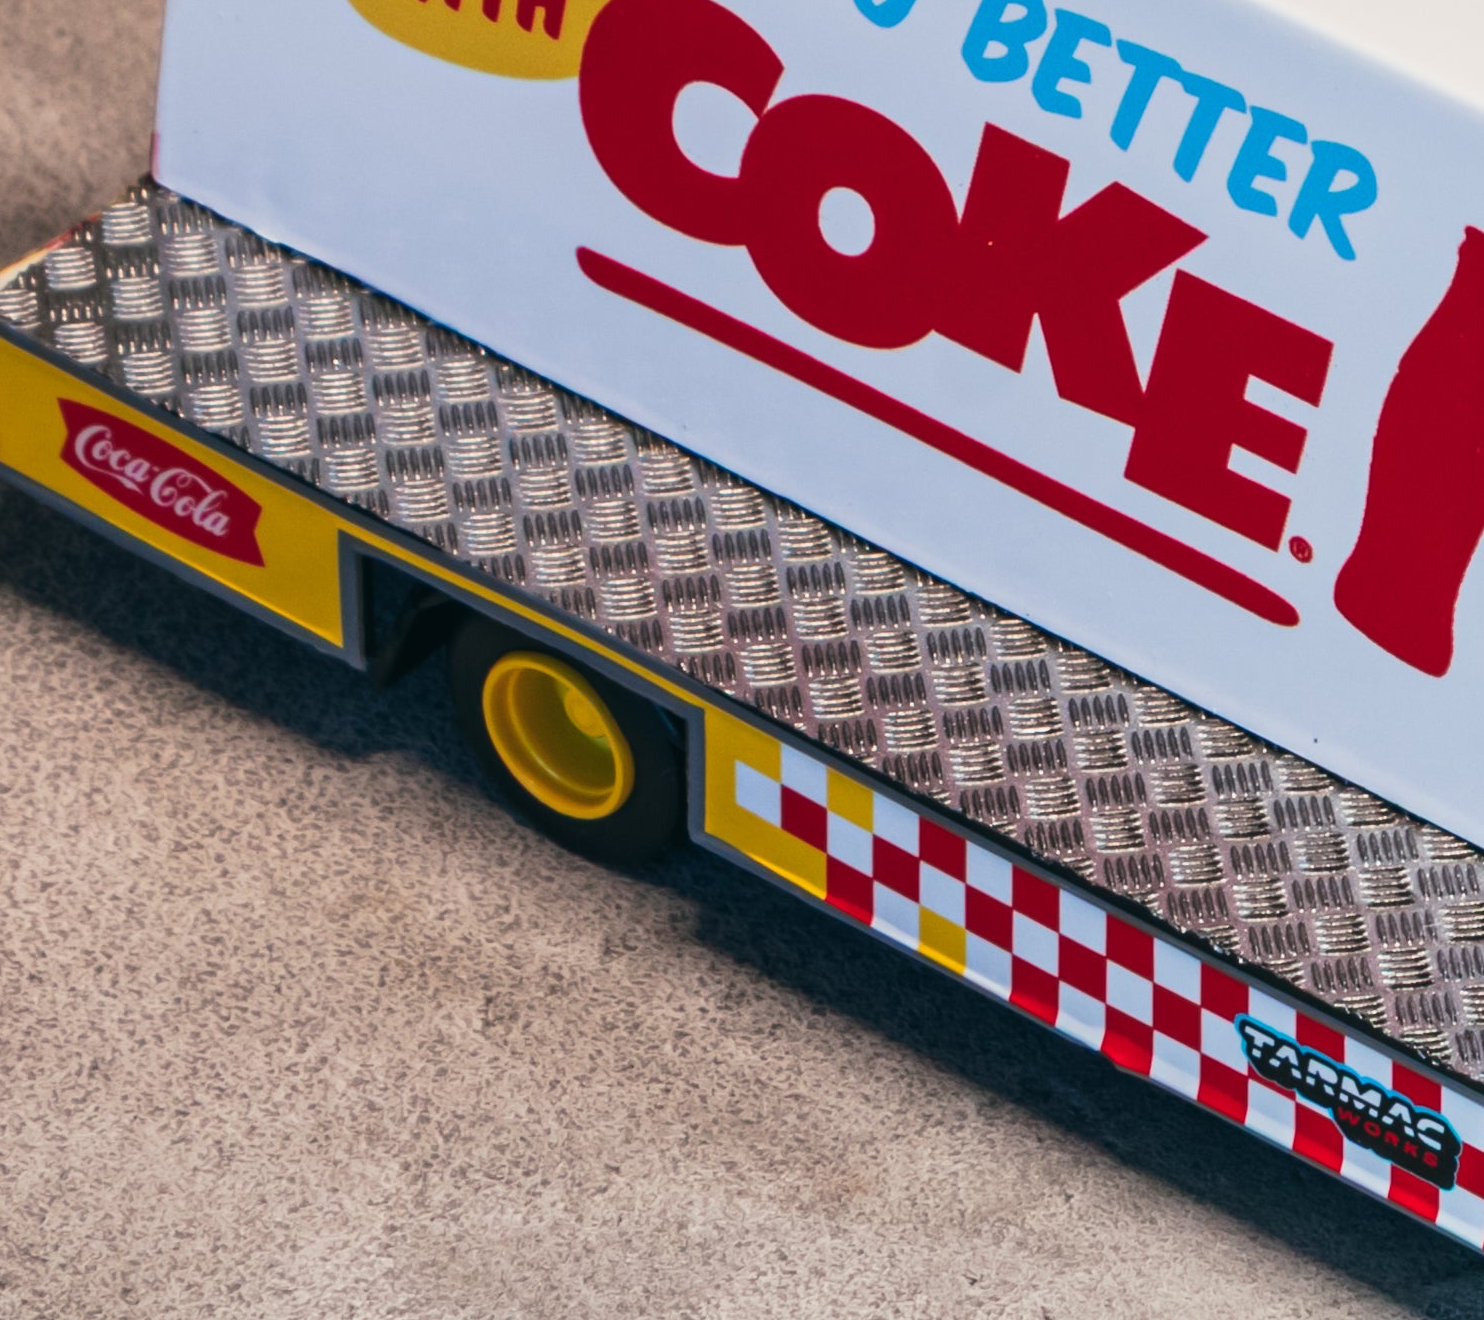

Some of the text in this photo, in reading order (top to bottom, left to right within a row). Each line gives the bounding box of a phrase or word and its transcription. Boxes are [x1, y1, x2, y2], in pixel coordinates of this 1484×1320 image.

[74, 424, 231, 538] Coca-Cola
[1243, 1023, 1445, 1151] TARMAC
[1336, 1105, 1439, 1170] WORKS
